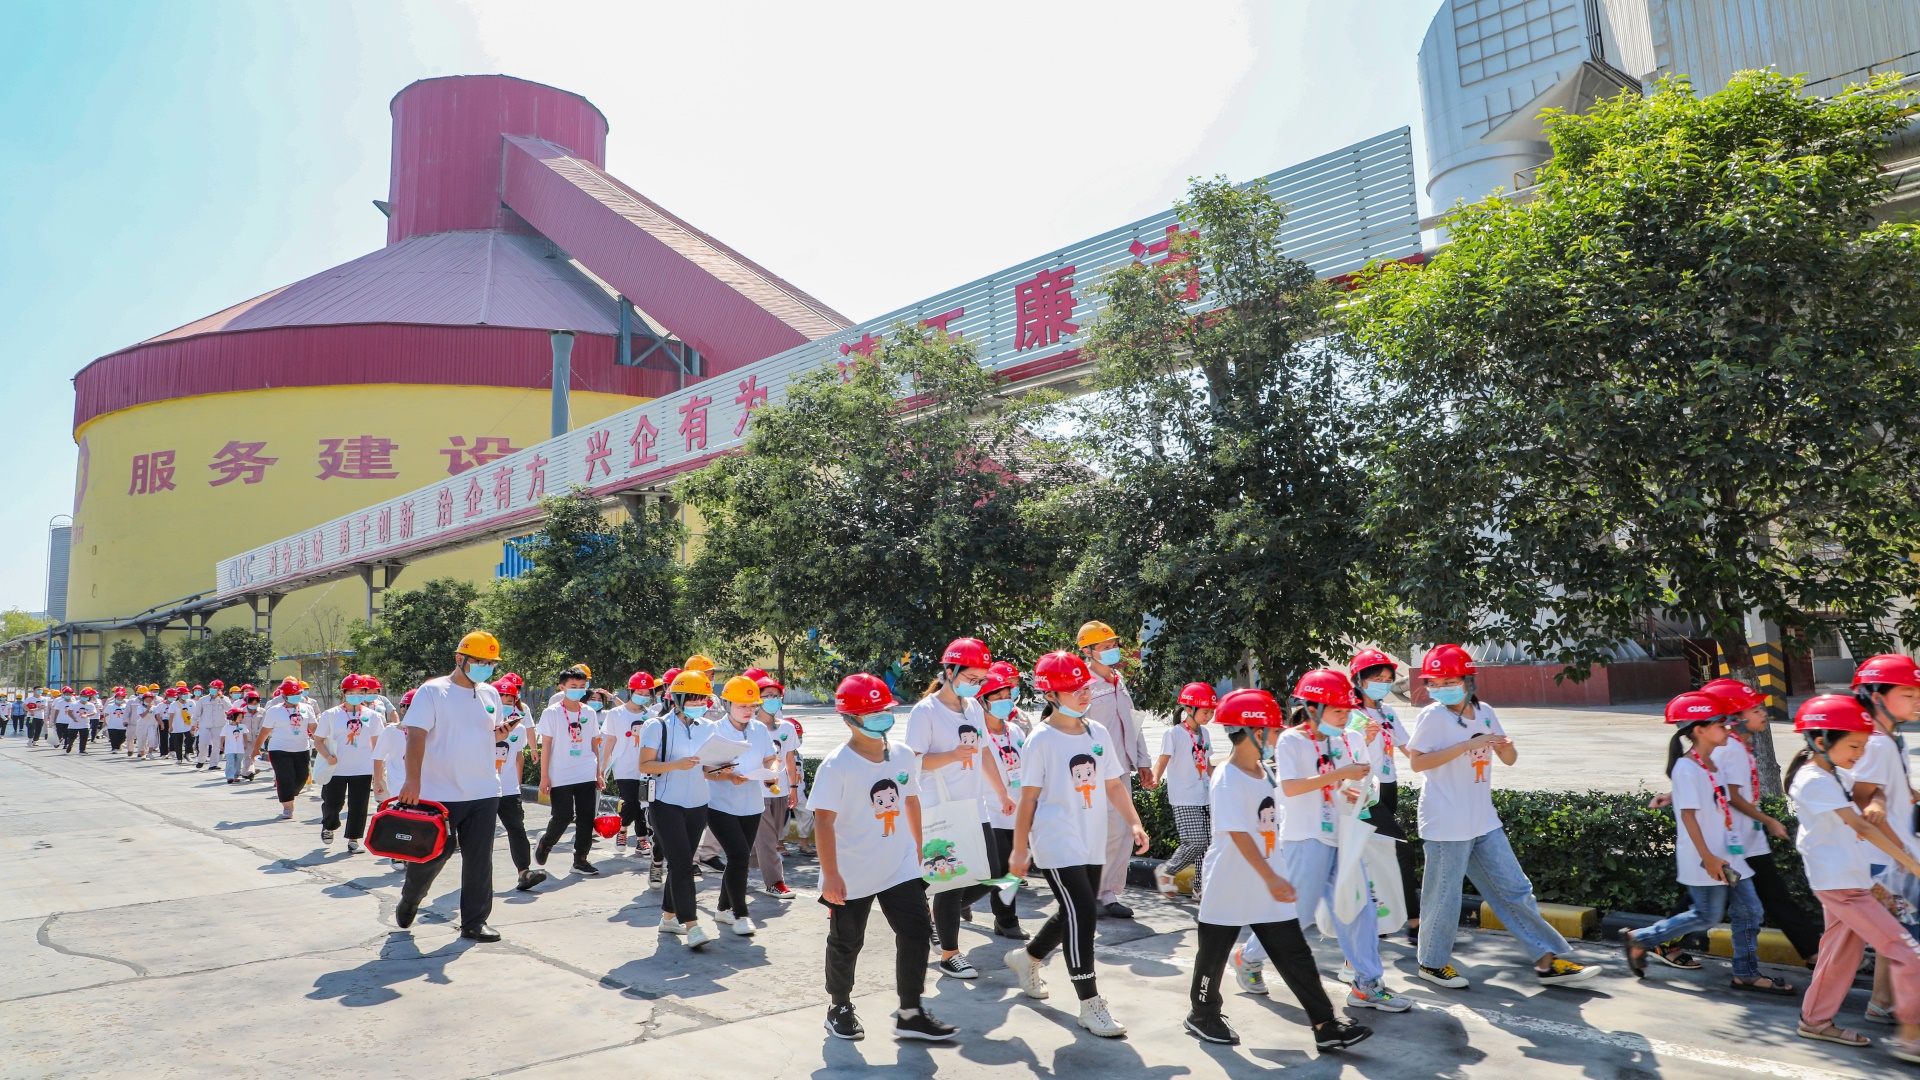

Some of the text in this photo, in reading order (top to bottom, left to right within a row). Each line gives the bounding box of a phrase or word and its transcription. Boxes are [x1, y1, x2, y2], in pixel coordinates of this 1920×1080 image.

[128, 435, 524, 497] 服务建设
[269, 530, 324, 575] 对党忠诚
[339, 500, 414, 555] 勇于创新
[436, 453, 548, 527] 治企有方
[585, 375, 768, 482] 兴企有为
[1304, 685, 1324, 694] CUCC
